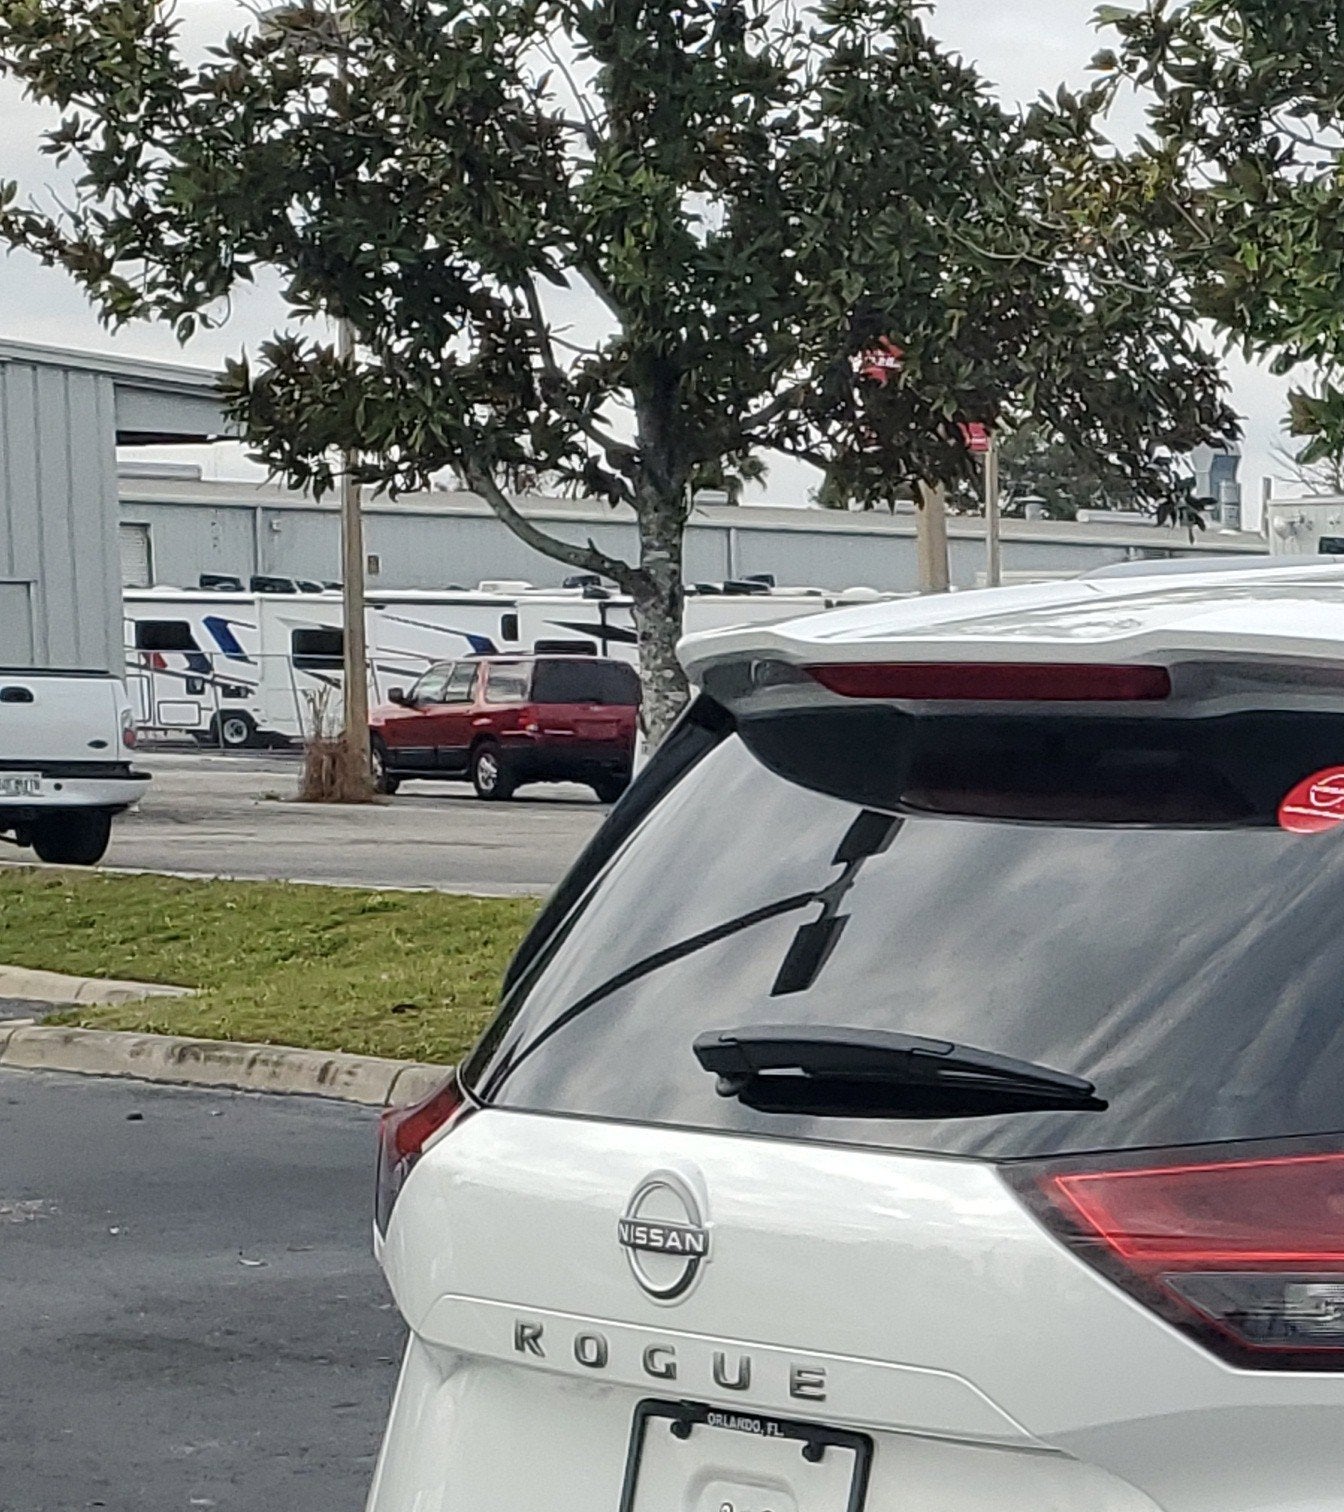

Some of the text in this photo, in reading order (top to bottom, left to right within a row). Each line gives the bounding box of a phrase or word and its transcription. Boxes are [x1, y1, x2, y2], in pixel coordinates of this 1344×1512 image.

[618, 1221, 704, 1252] NISSAN
[514, 1317, 828, 1402] ROGUE
[706, 1411, 765, 1434] ORLANDO,
